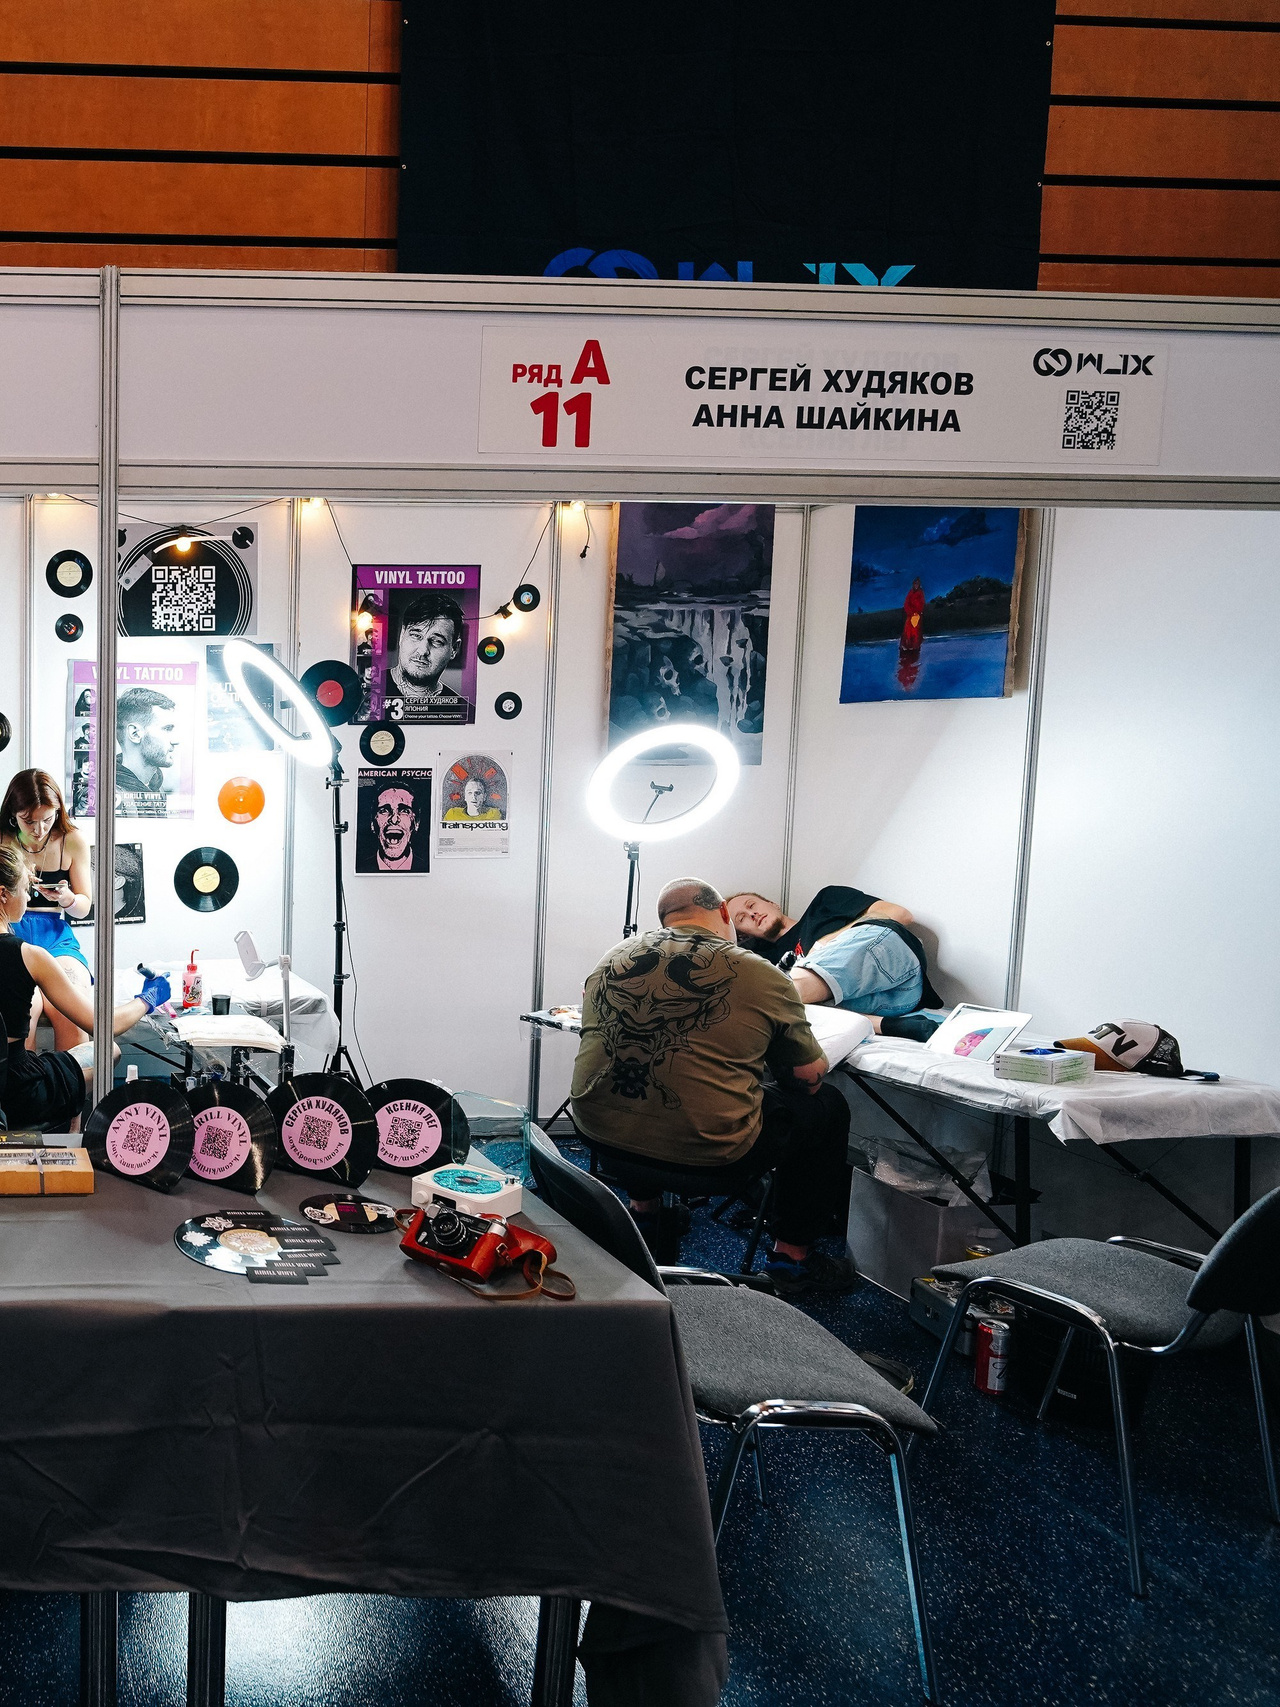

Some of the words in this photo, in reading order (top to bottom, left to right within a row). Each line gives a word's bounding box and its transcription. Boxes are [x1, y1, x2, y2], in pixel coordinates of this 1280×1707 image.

[512, 364, 563, 389] РЯД
[685, 362, 811, 393] СЕРГЕЙ
[820, 369, 975, 398] ХУДЯКОВ
[530, 392, 592, 448] 11
[692, 403, 786, 430] АННА
[794, 400, 962, 433] ШАЙКИНА
[375, 571, 412, 585] VINYL
[416, 571, 465, 585] TATTOO
[134, 667, 183, 681] TATTOO
[382, 698, 404, 720] #3
[429, 697, 458, 705] ХУДЯКОВ
[440, 821, 509, 832] Trainspotting
[112, 1106, 140, 1134] ANNY
[145, 1107, 168, 1142] VINYL
[227, 1113, 248, 1147] VINYL
[285, 1098, 313, 1128] СЕРГЕЙ
[315, 1099, 350, 1135] ХУДЯКОВ
[422, 1111, 438, 1129] ЛЕГ
[110, 1140, 159, 1171] vk.com/anny_vinyl
